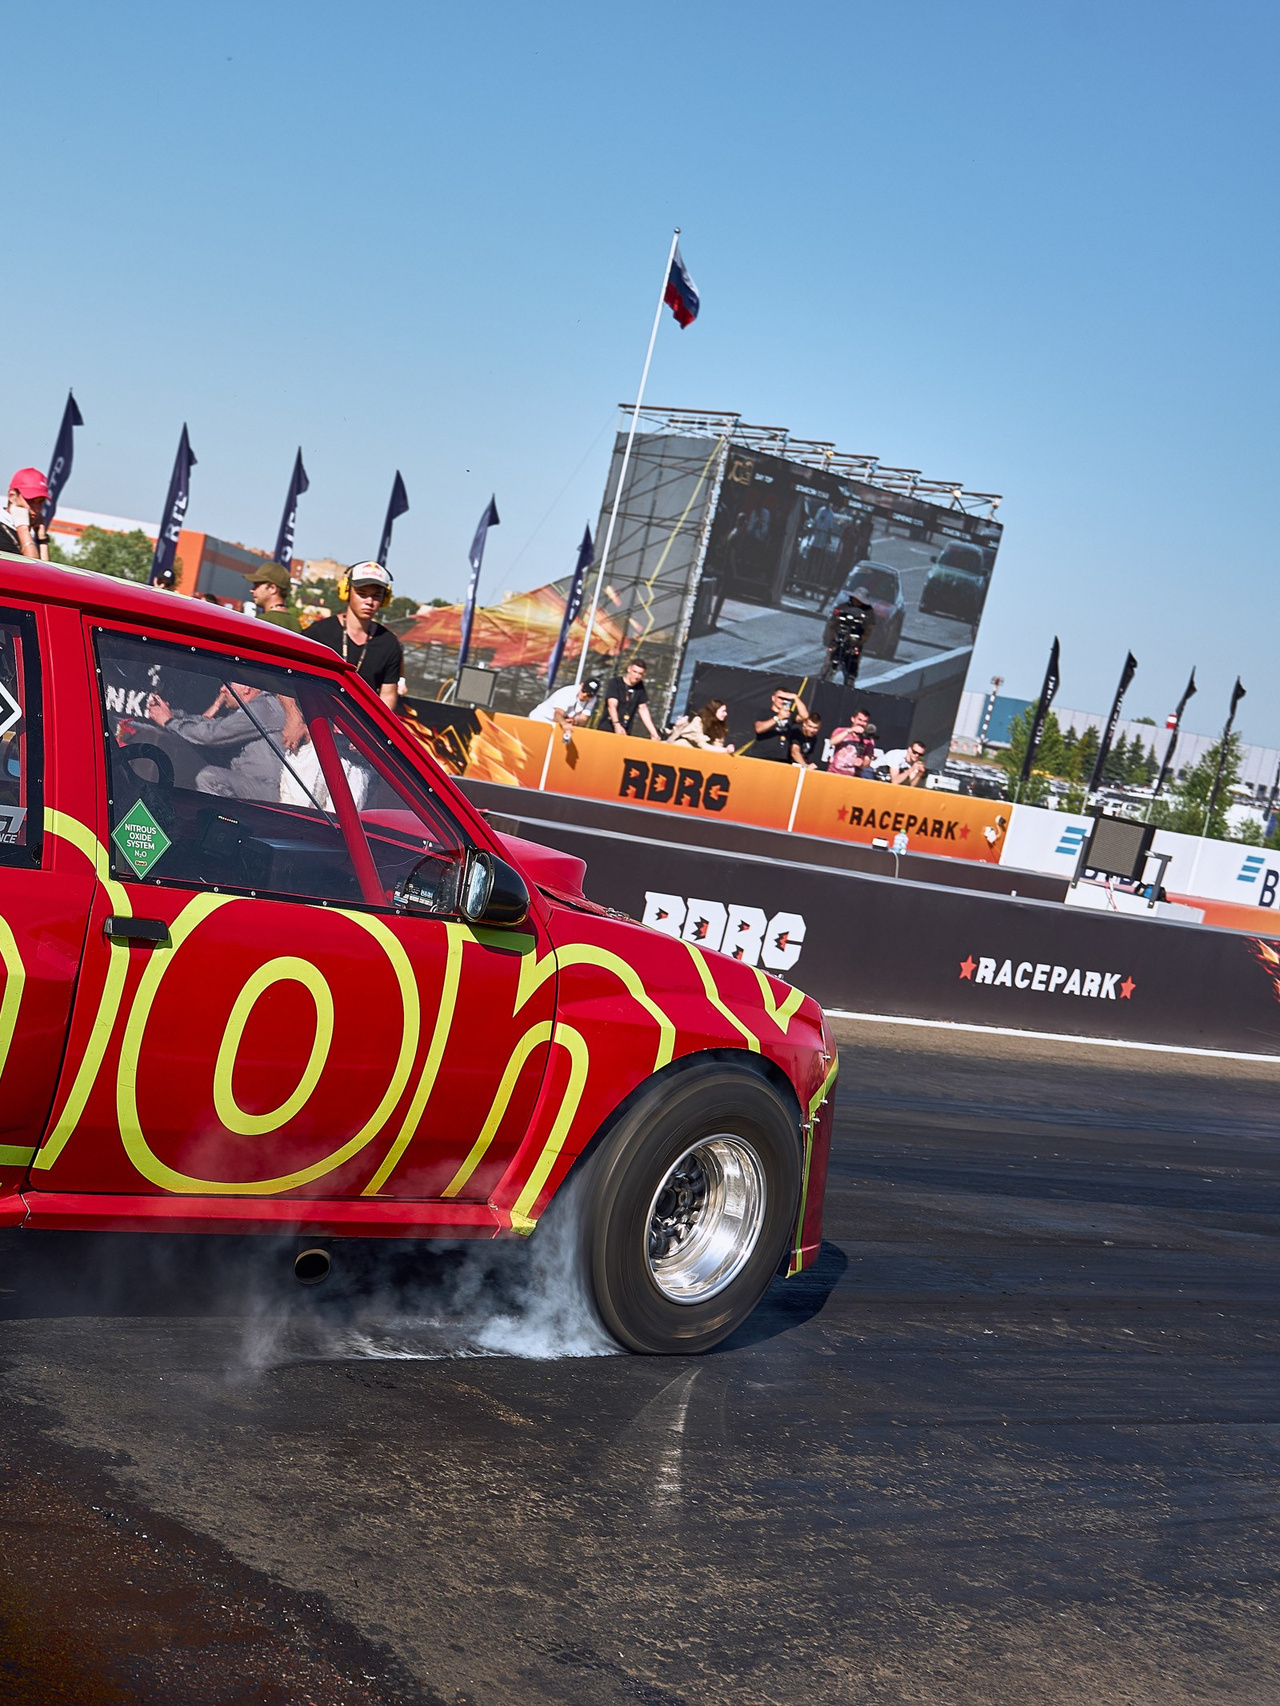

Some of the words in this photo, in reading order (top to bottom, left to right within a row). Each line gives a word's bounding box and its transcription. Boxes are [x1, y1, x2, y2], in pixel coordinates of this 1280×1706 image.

[621, 758, 730, 812] RDRC
[124, 823, 157, 835] NITROUS
[849, 805, 959, 842] RACEPARK
[126, 840, 155, 850] SYSTEM
[129, 832, 152, 842] OXIDE
[974, 957, 1122, 1000] RACEPARK
